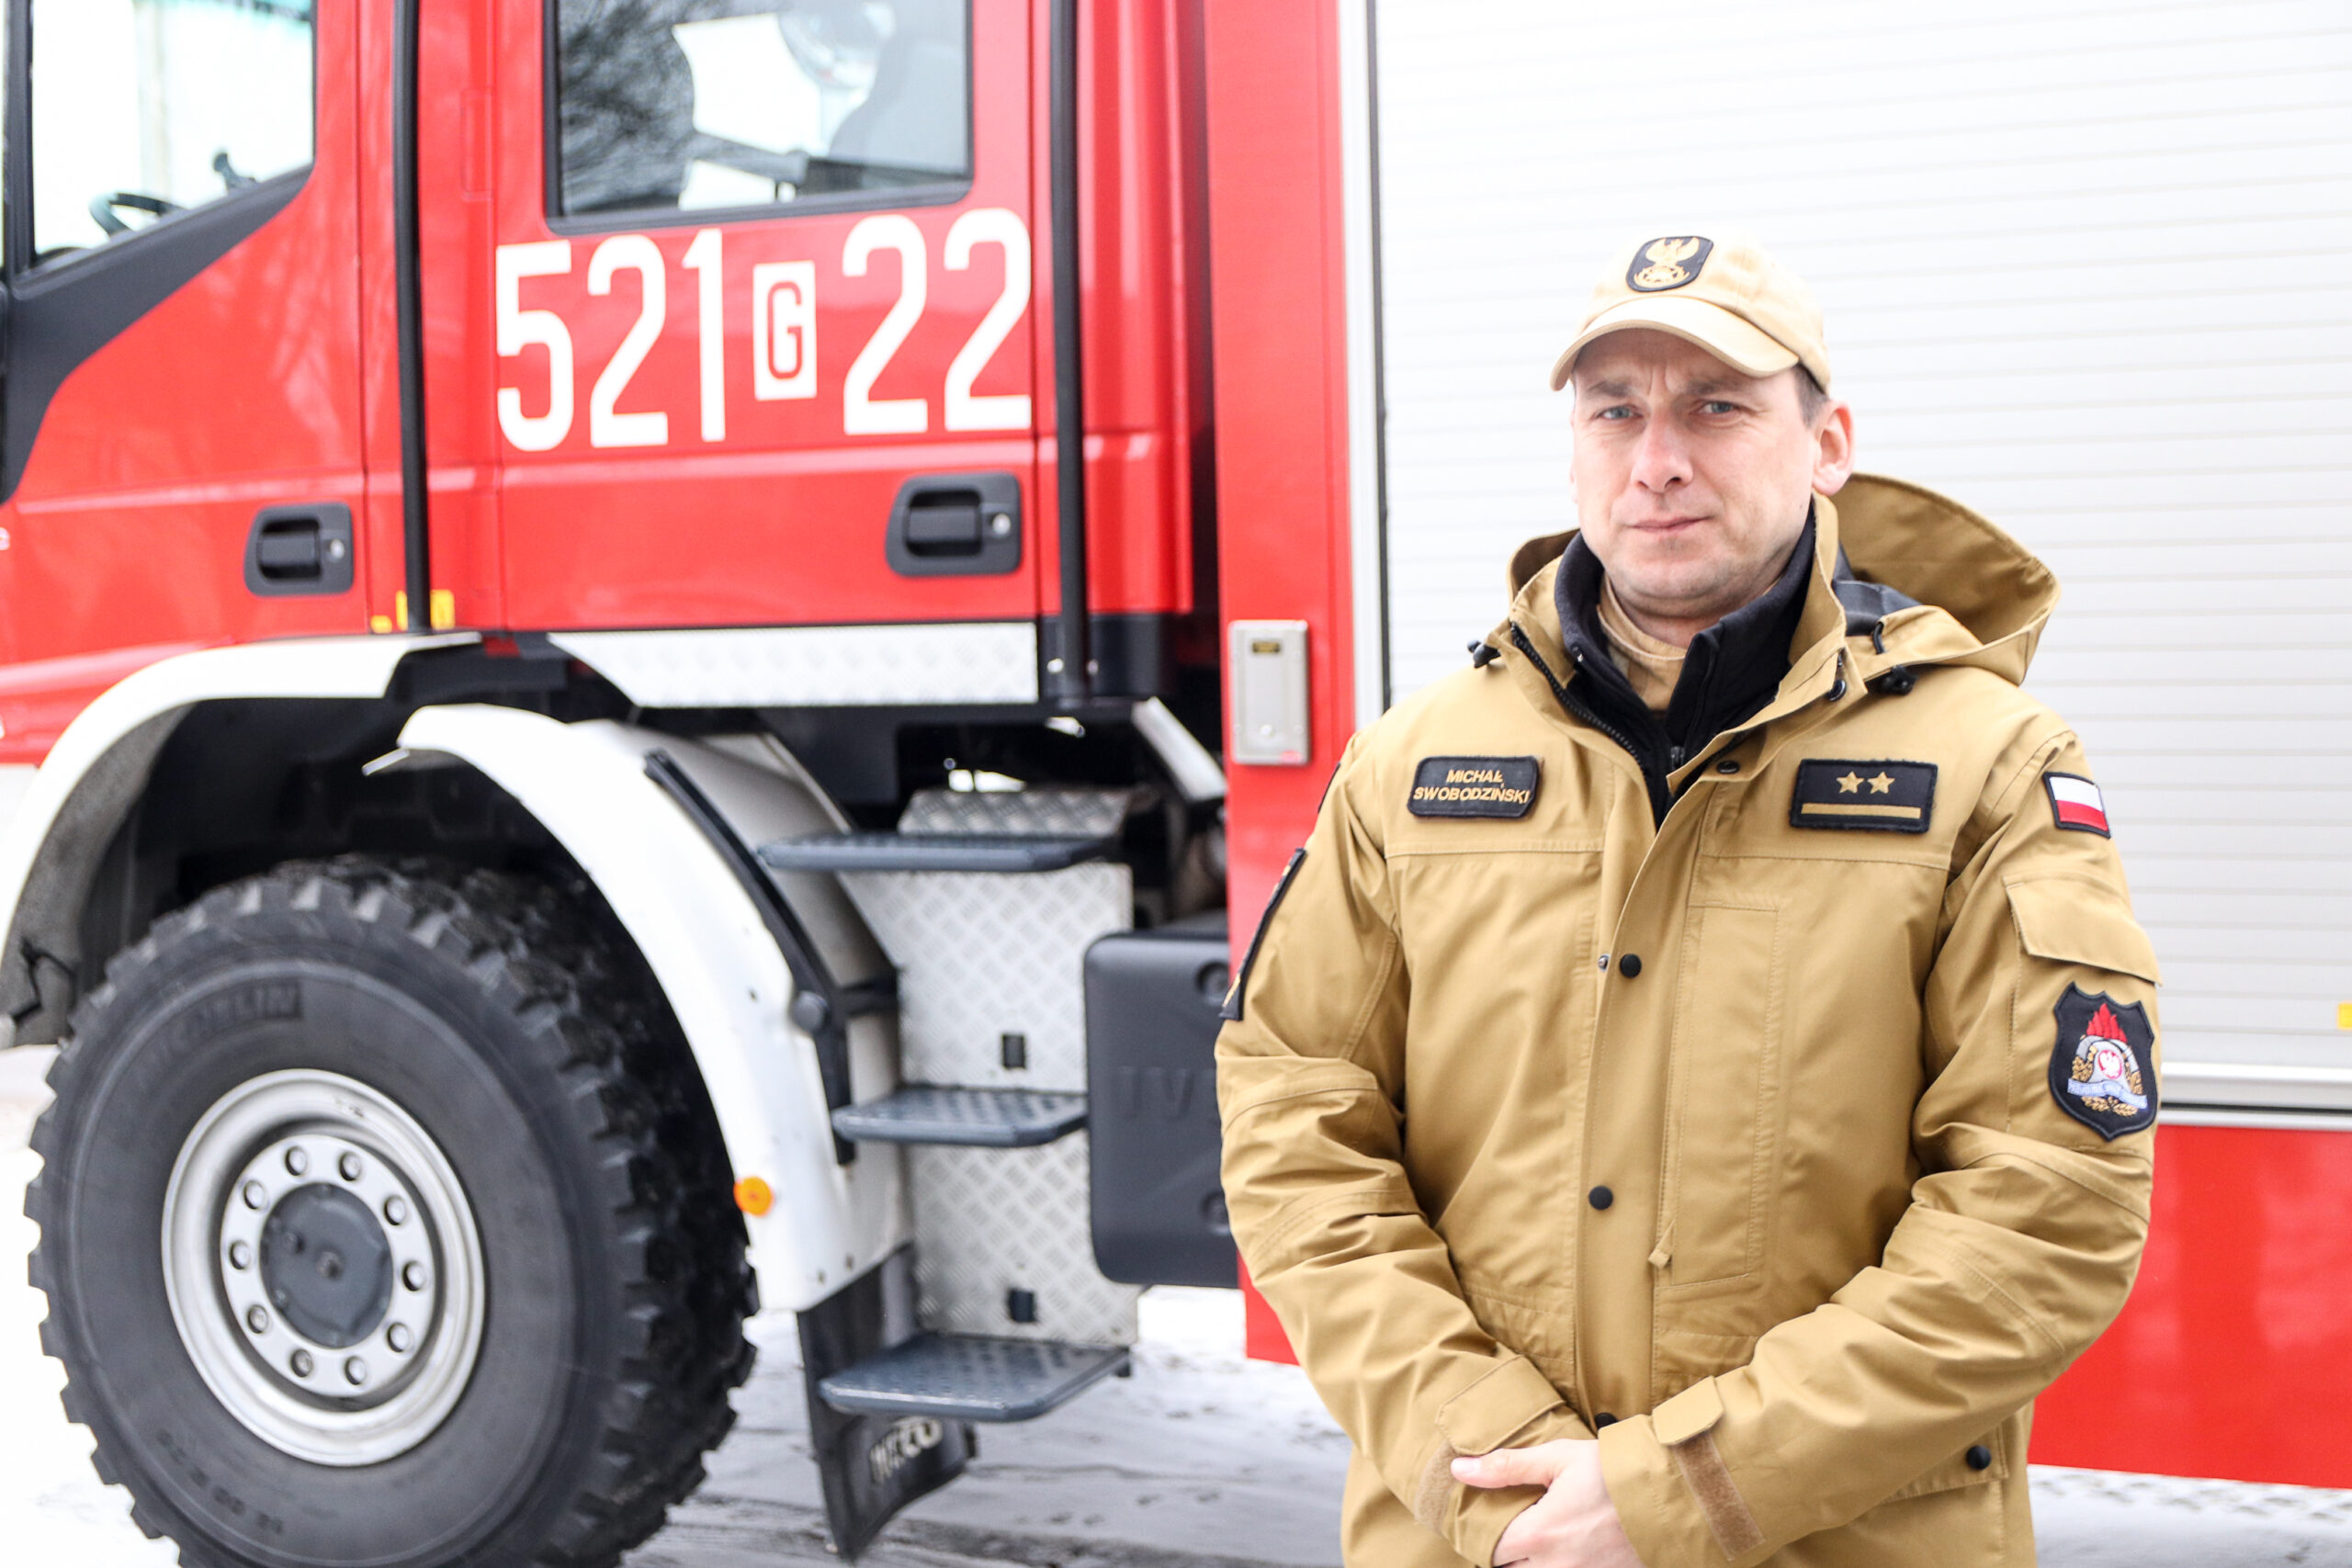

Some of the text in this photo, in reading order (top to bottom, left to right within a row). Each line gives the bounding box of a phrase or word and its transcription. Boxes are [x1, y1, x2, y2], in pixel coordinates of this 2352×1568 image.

[495, 208, 1032, 451] 521 G 22
[1446, 769, 1504, 784] MICHAŁ
[1413, 783, 1532, 805] SWOBODZIŃSKI
